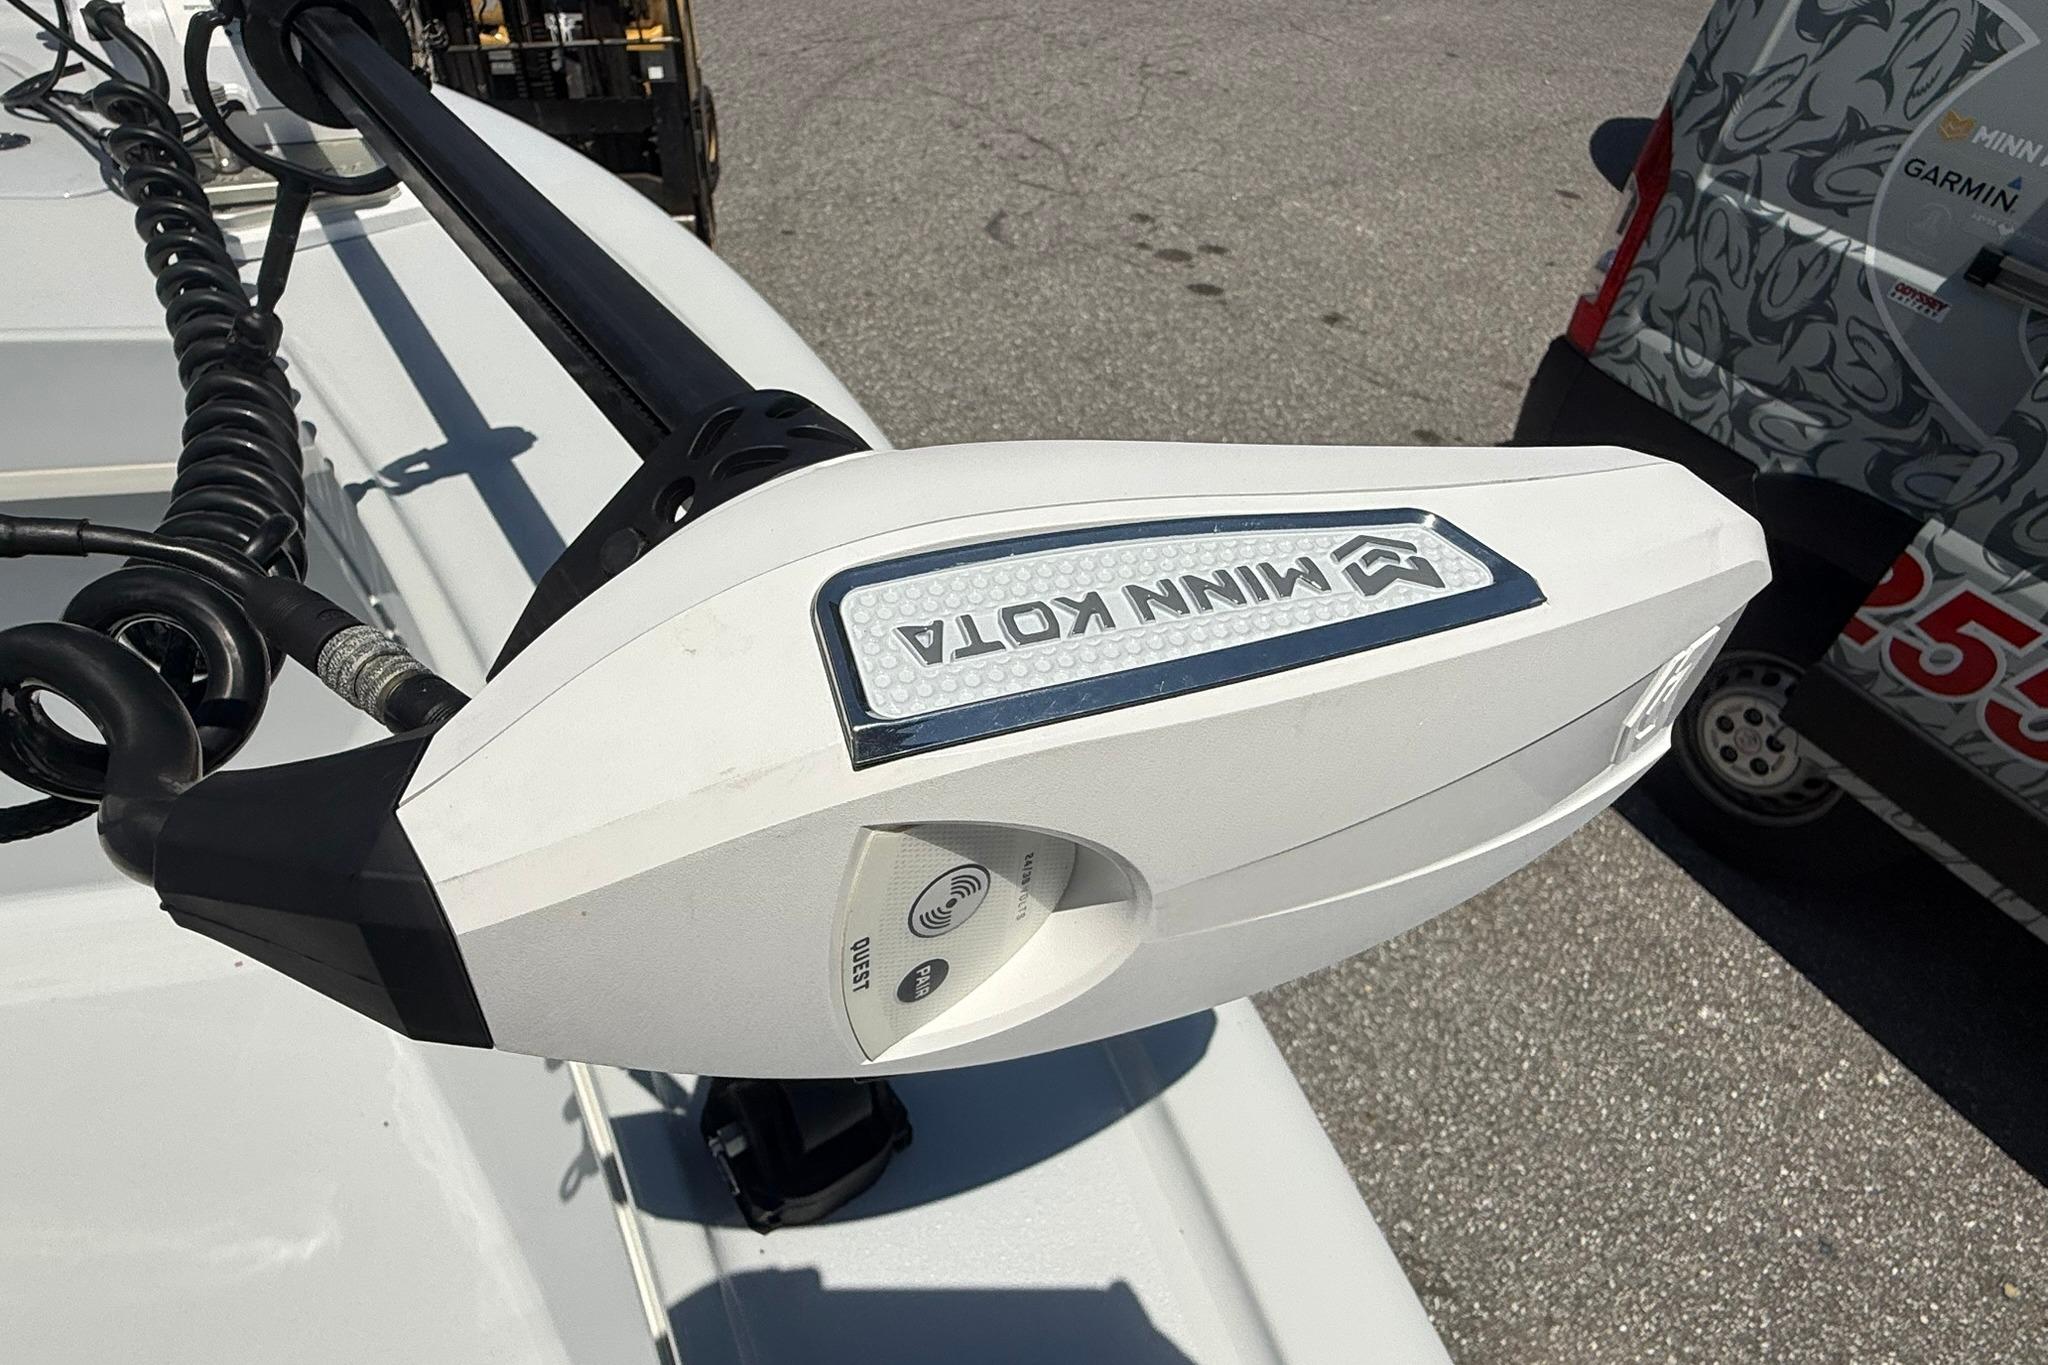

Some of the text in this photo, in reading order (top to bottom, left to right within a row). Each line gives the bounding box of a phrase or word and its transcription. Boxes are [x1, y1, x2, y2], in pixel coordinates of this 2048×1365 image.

[1972, 126, 2044, 163] MINN
[1904, 158, 2019, 213] GARMIN
[1895, 282, 1950, 312] ODYSSEY
[893, 556, 1332, 667] MINN KOTA
[850, 936, 870, 992] QUEST
[914, 964, 932, 1000] PAIR
